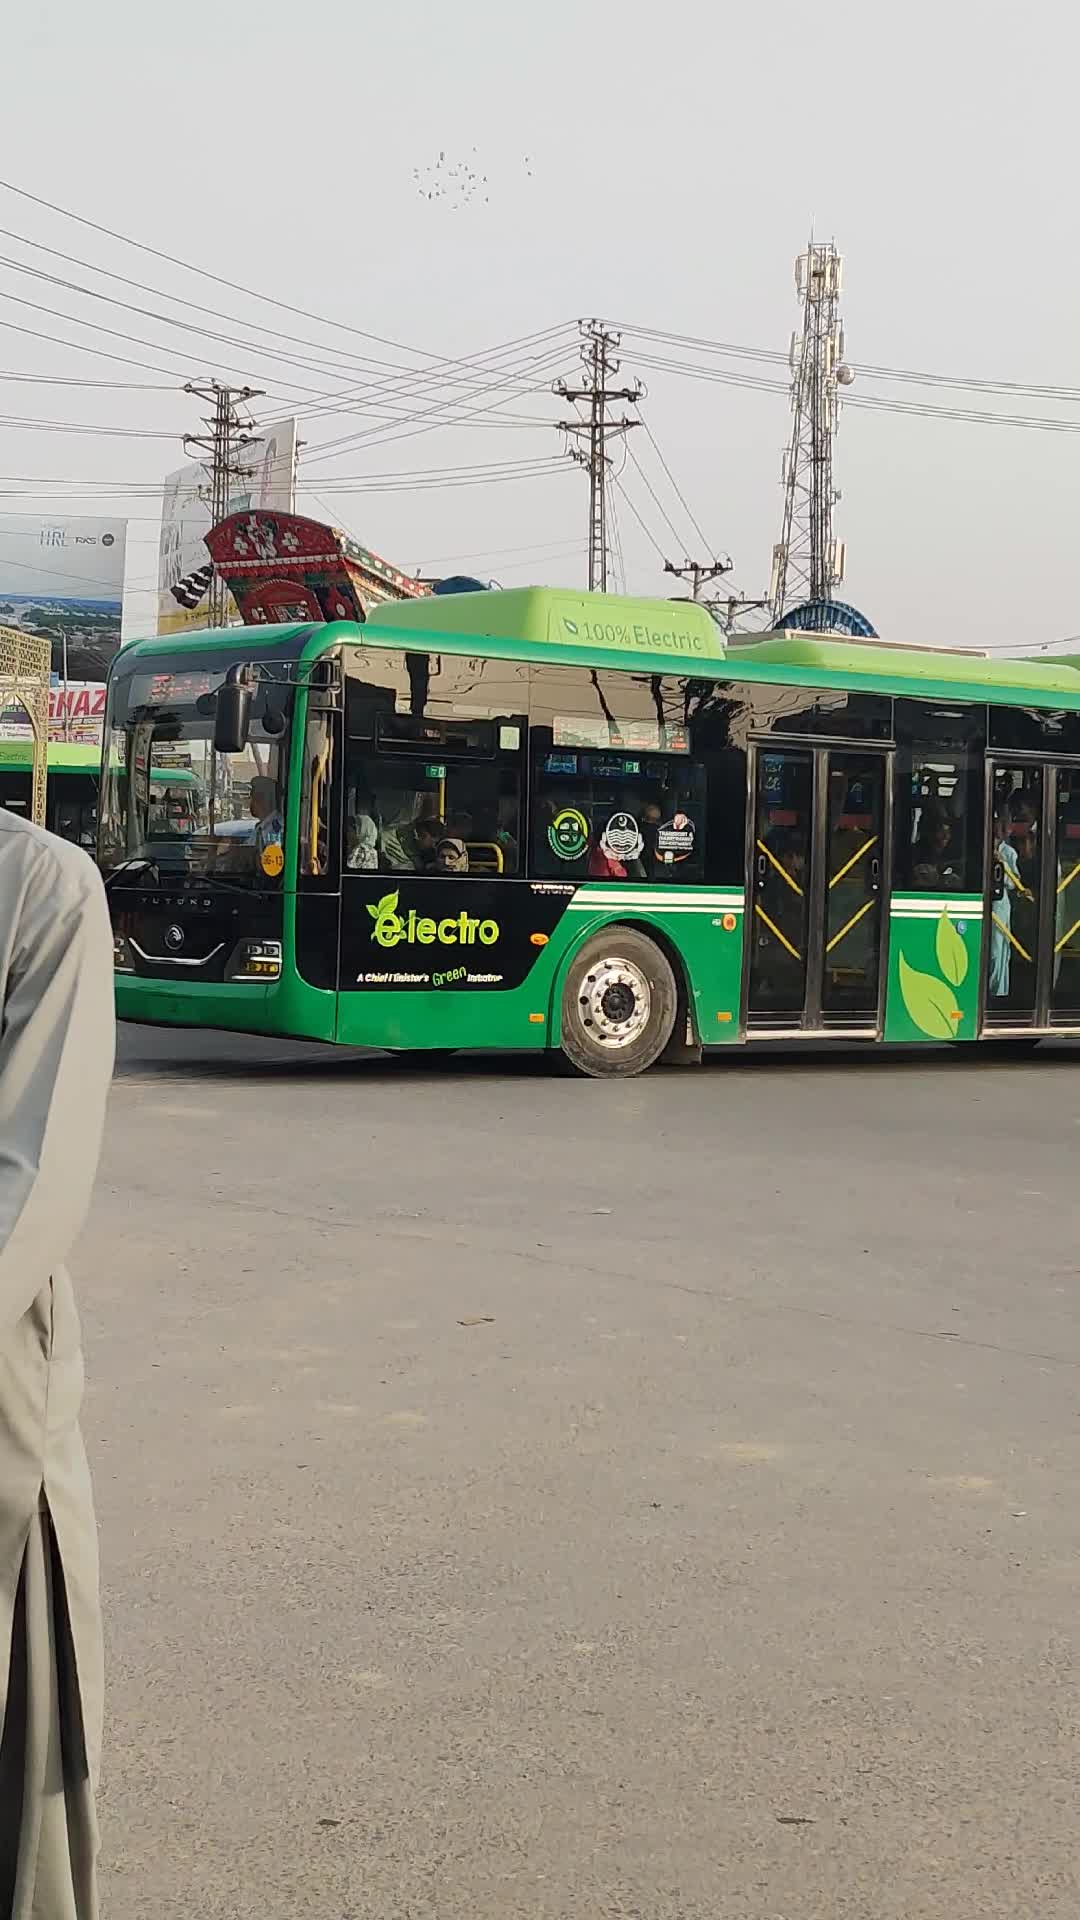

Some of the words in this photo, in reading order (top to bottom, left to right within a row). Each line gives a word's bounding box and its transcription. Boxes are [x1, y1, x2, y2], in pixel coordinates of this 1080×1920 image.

[583, 623, 631, 644] 100%
[633, 625, 702, 650] Electric
[375, 909, 500, 947] electro
[432, 966, 467, 987] Green
